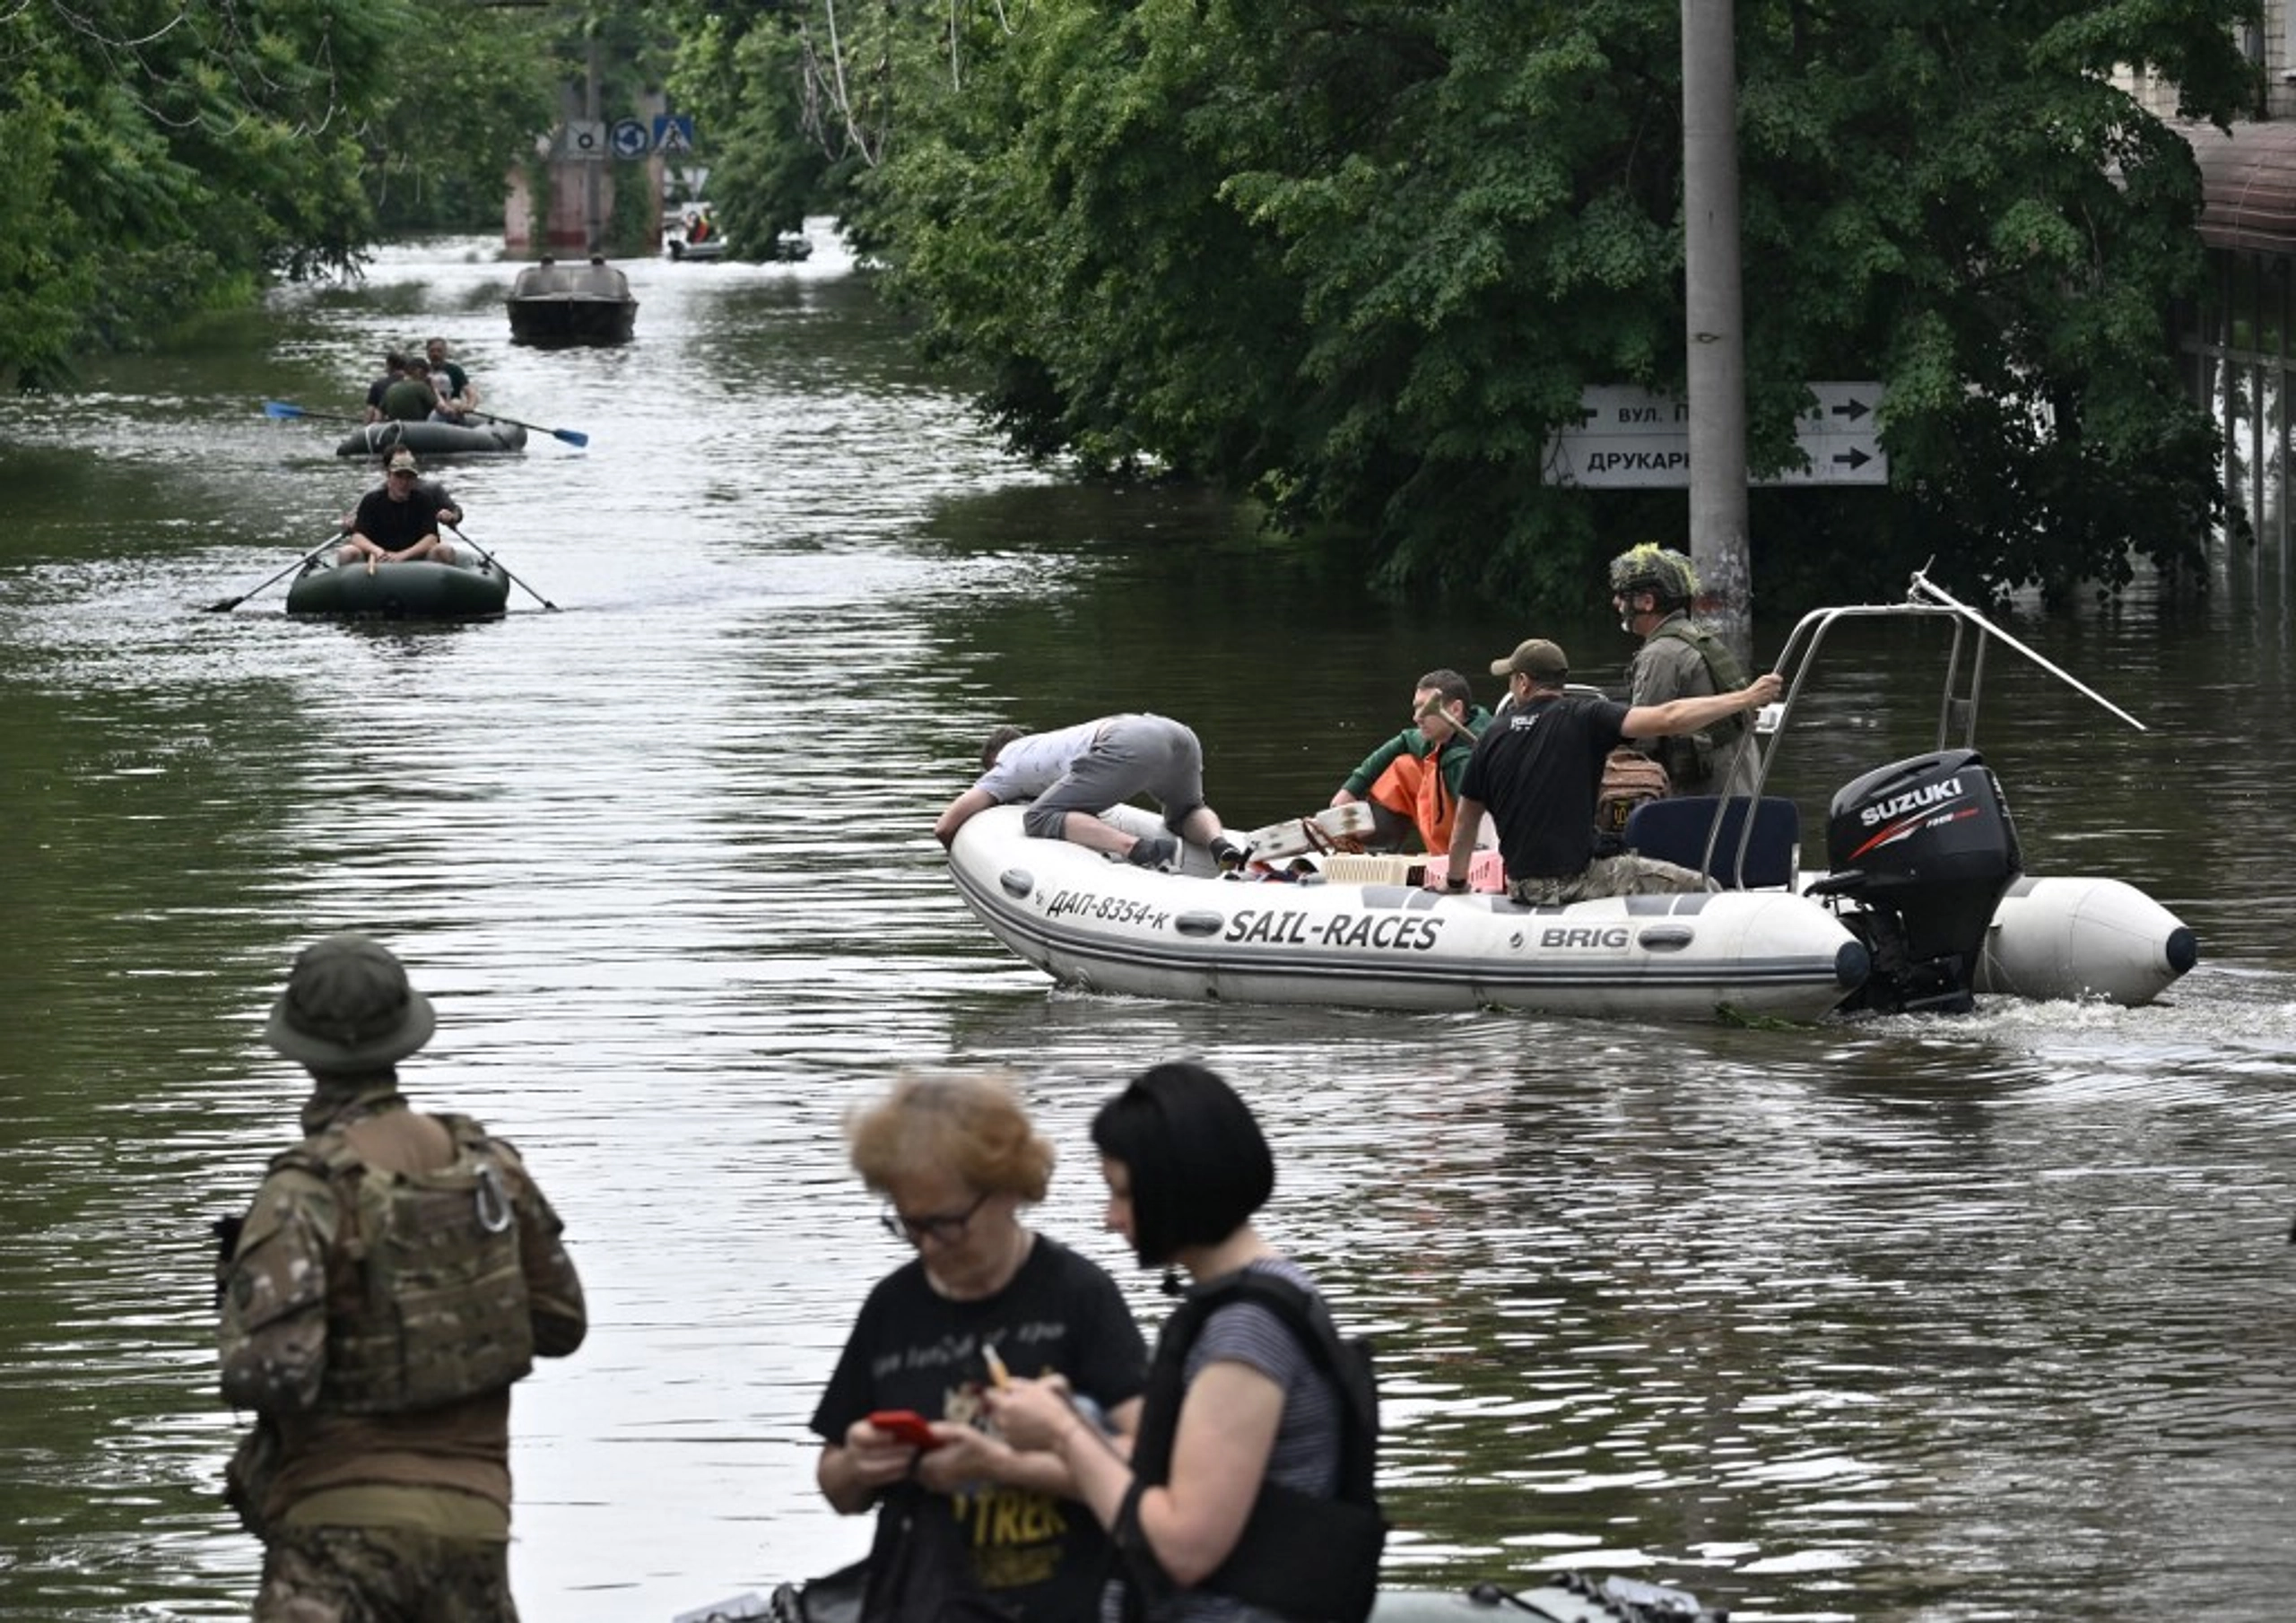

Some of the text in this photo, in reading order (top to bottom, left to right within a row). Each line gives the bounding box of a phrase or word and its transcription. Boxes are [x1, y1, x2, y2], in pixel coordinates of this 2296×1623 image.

[1618, 407, 1663, 423] ВУЛ.
[1859, 777, 1963, 827] SUZUKI
[1224, 910, 1445, 950] SAIL-RACES
[1540, 927, 1629, 948] BRIG
